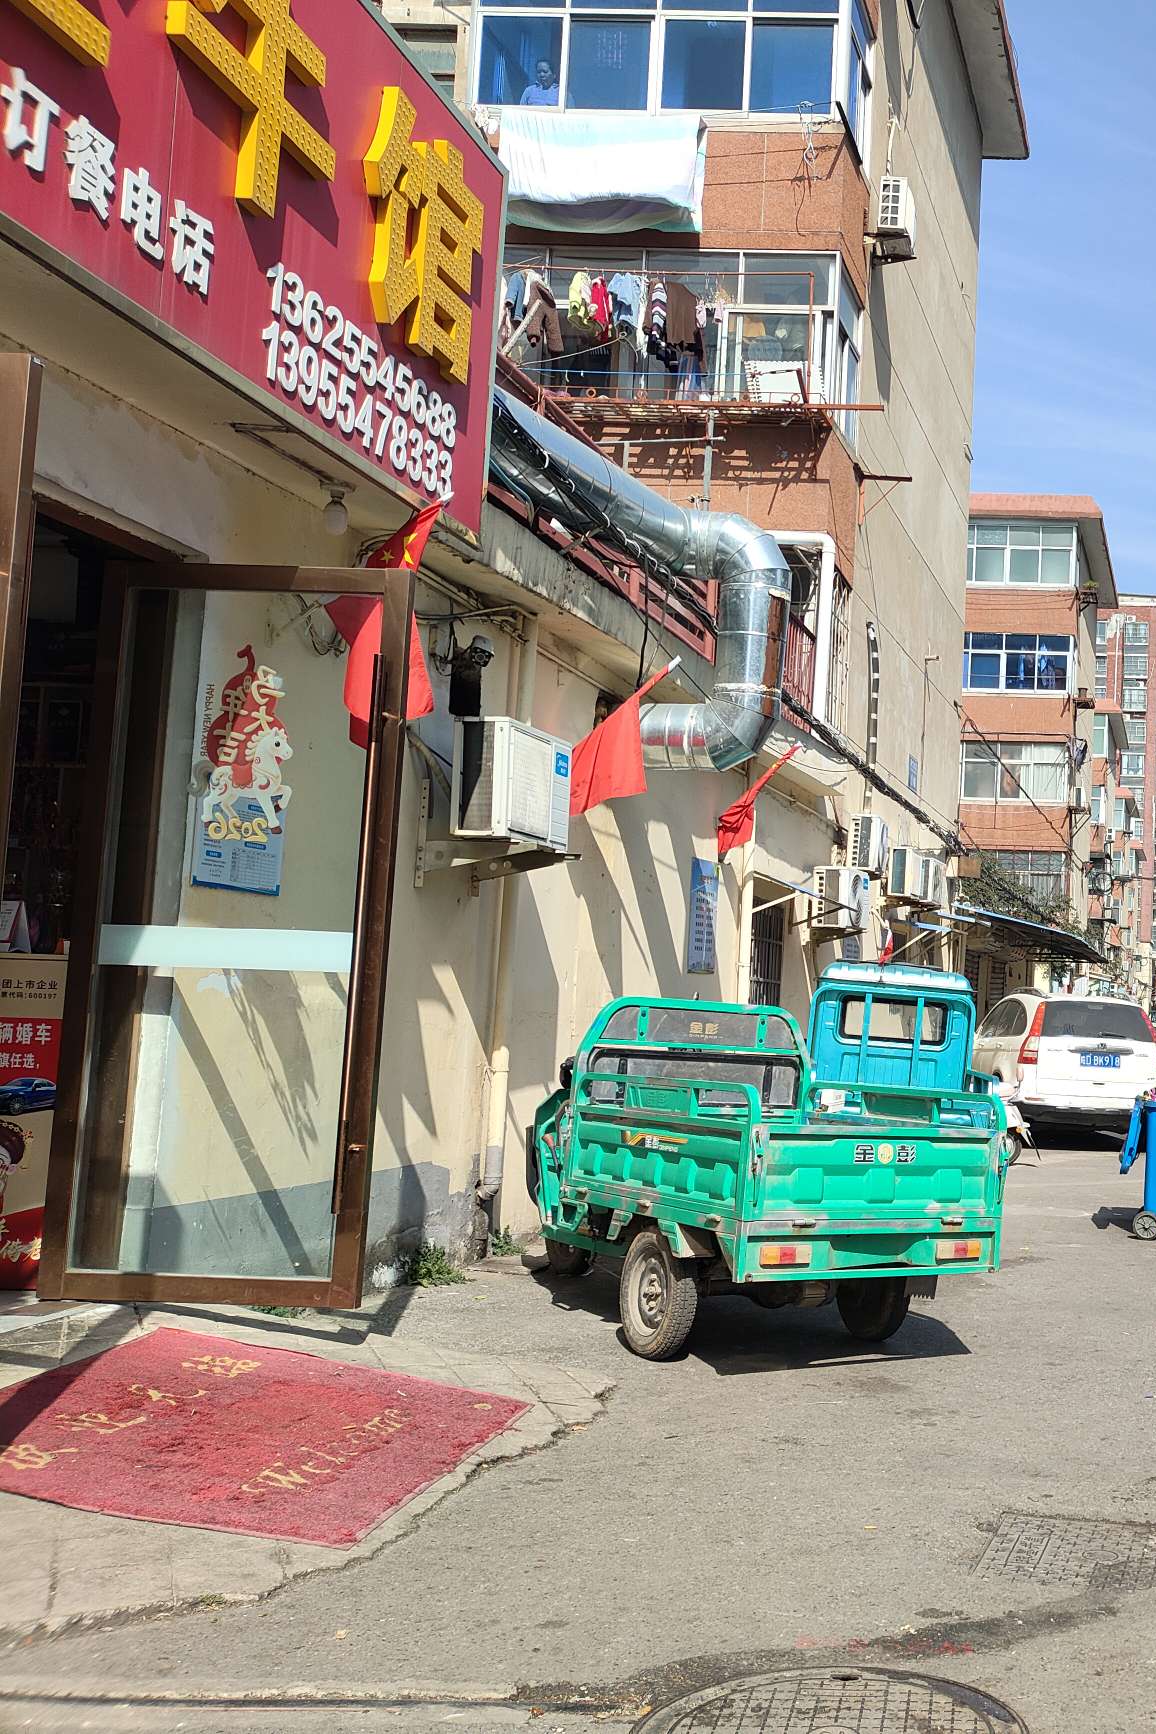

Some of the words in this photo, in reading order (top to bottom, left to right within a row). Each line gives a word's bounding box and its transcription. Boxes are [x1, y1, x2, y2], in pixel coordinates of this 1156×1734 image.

[0, 66, 214, 295] 订餐电话
[261, 321, 454, 496] 13955478333
[266, 262, 457, 448] 13625545688
